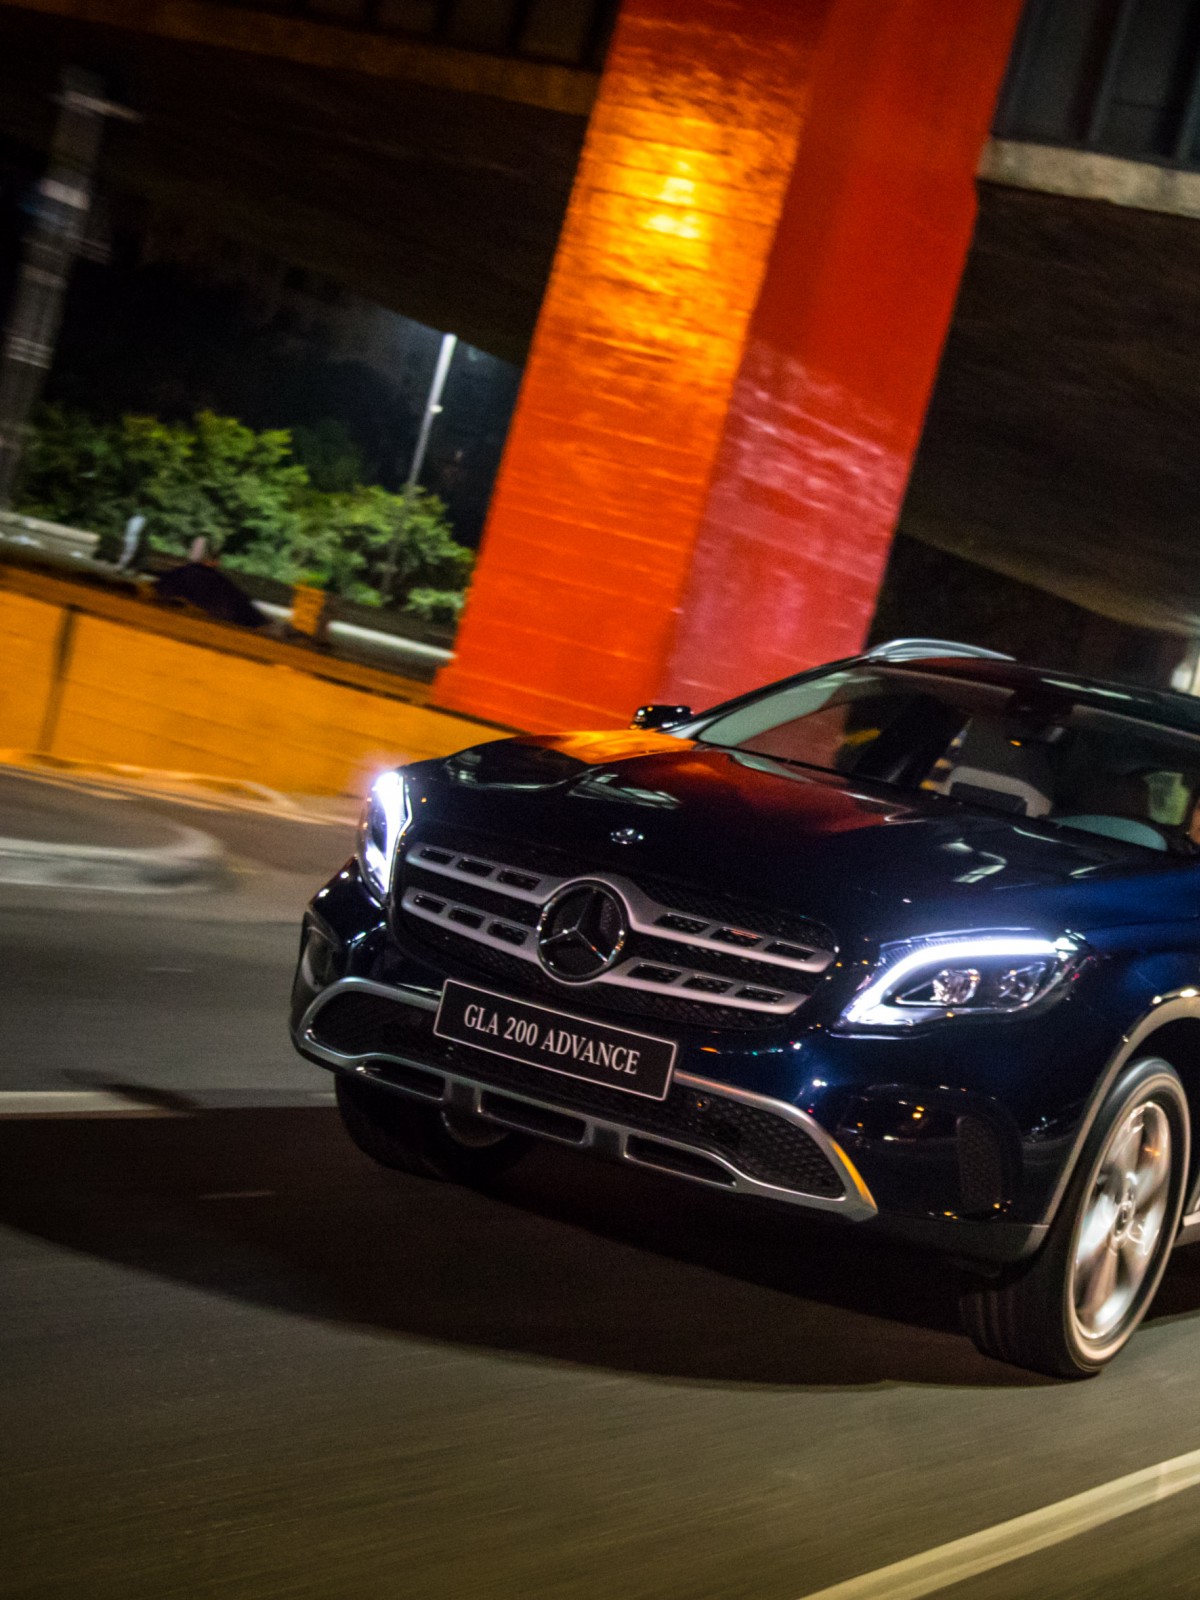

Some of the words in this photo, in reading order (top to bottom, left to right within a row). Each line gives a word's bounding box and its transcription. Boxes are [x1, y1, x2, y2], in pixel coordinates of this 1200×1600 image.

[464, 1004, 499, 1036] GLA
[504, 1017, 539, 1046] 200
[541, 1029, 640, 1075] ADVANCE
